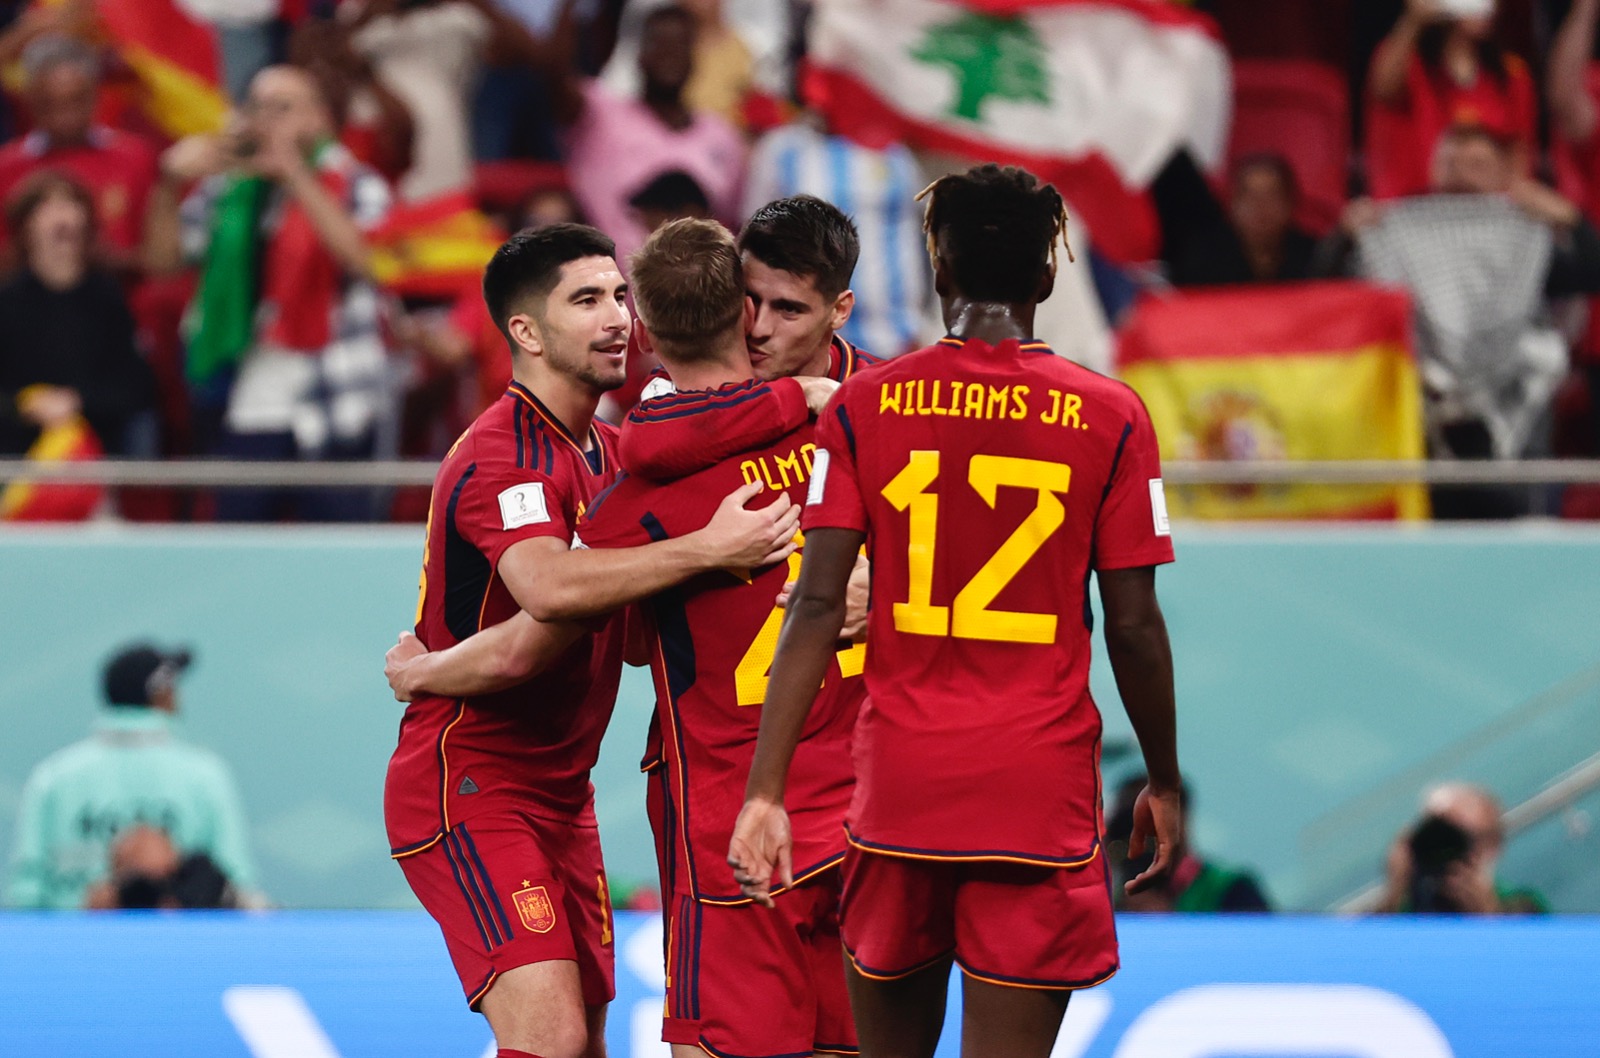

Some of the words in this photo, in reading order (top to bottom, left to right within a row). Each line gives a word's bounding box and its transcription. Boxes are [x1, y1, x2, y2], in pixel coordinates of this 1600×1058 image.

[879, 379, 1031, 420] WILLIAMS
[1040, 389, 1089, 430] JR.
[880, 450, 1072, 644] 12
